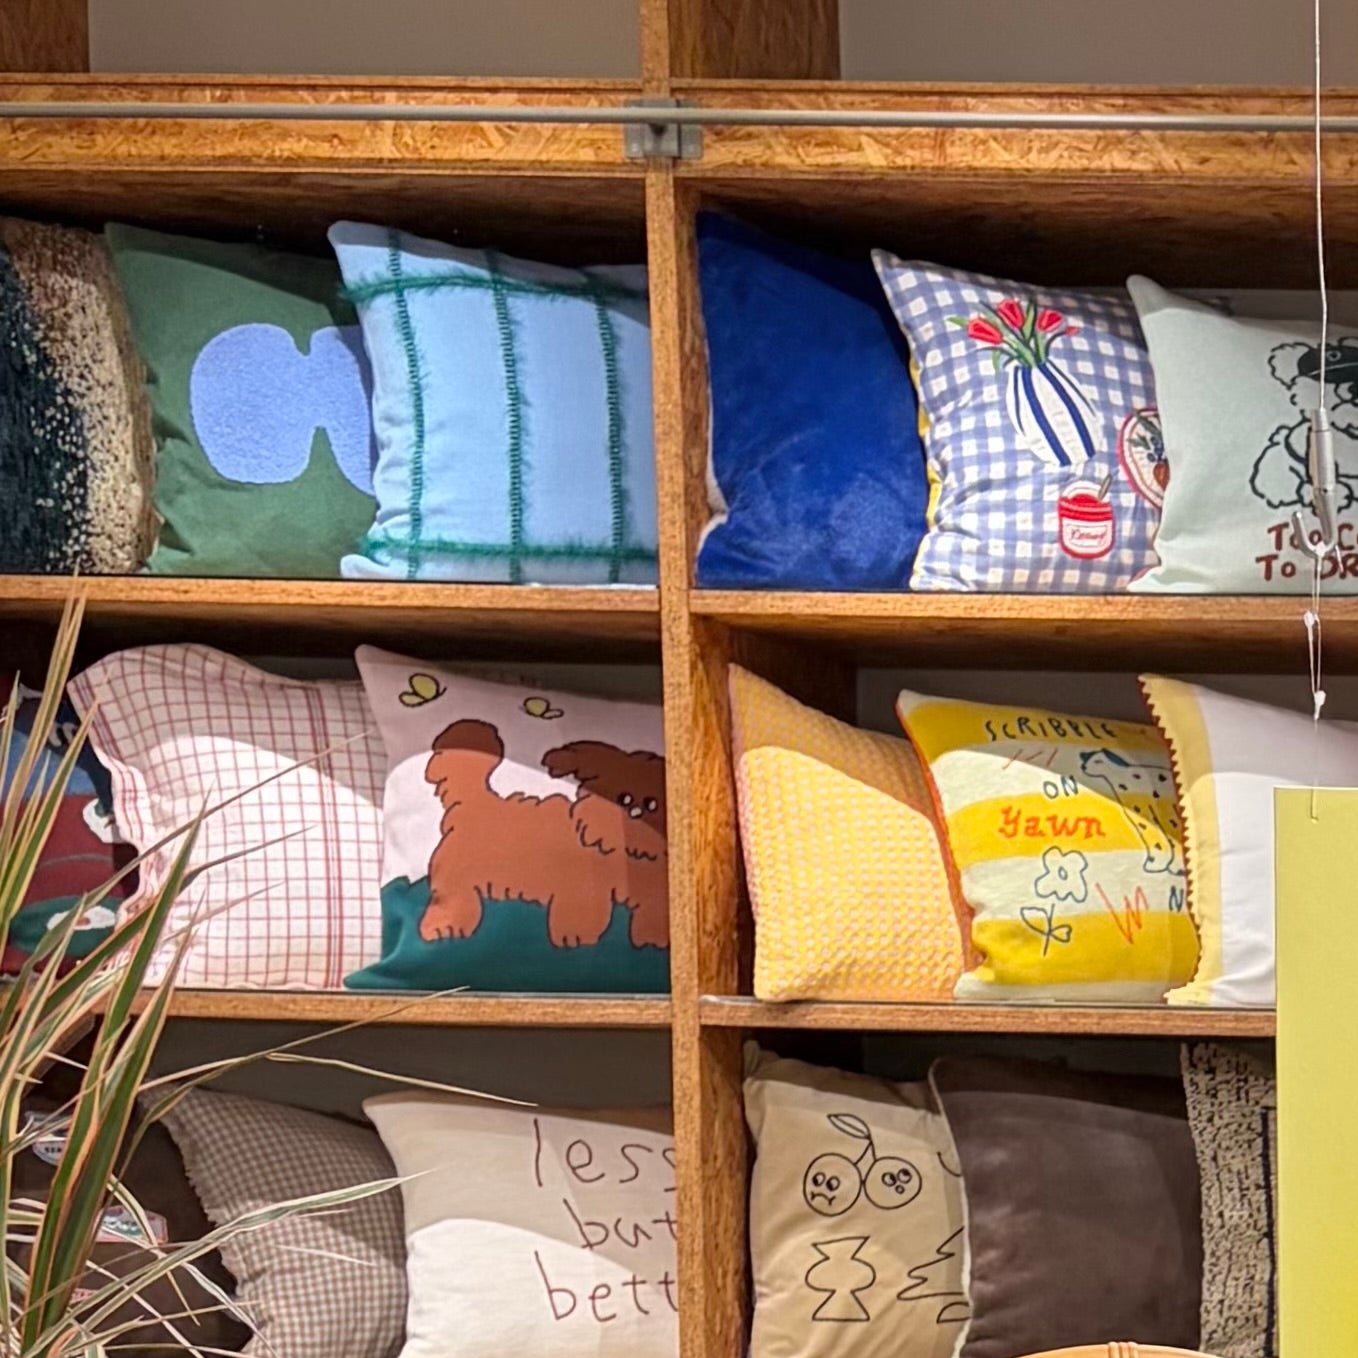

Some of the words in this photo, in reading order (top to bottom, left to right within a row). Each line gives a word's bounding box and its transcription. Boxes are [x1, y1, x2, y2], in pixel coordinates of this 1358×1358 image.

[985, 715, 1117, 741] SCRIBBLE
[1043, 775, 1079, 799] ON
[534, 1250, 680, 1325] bett
